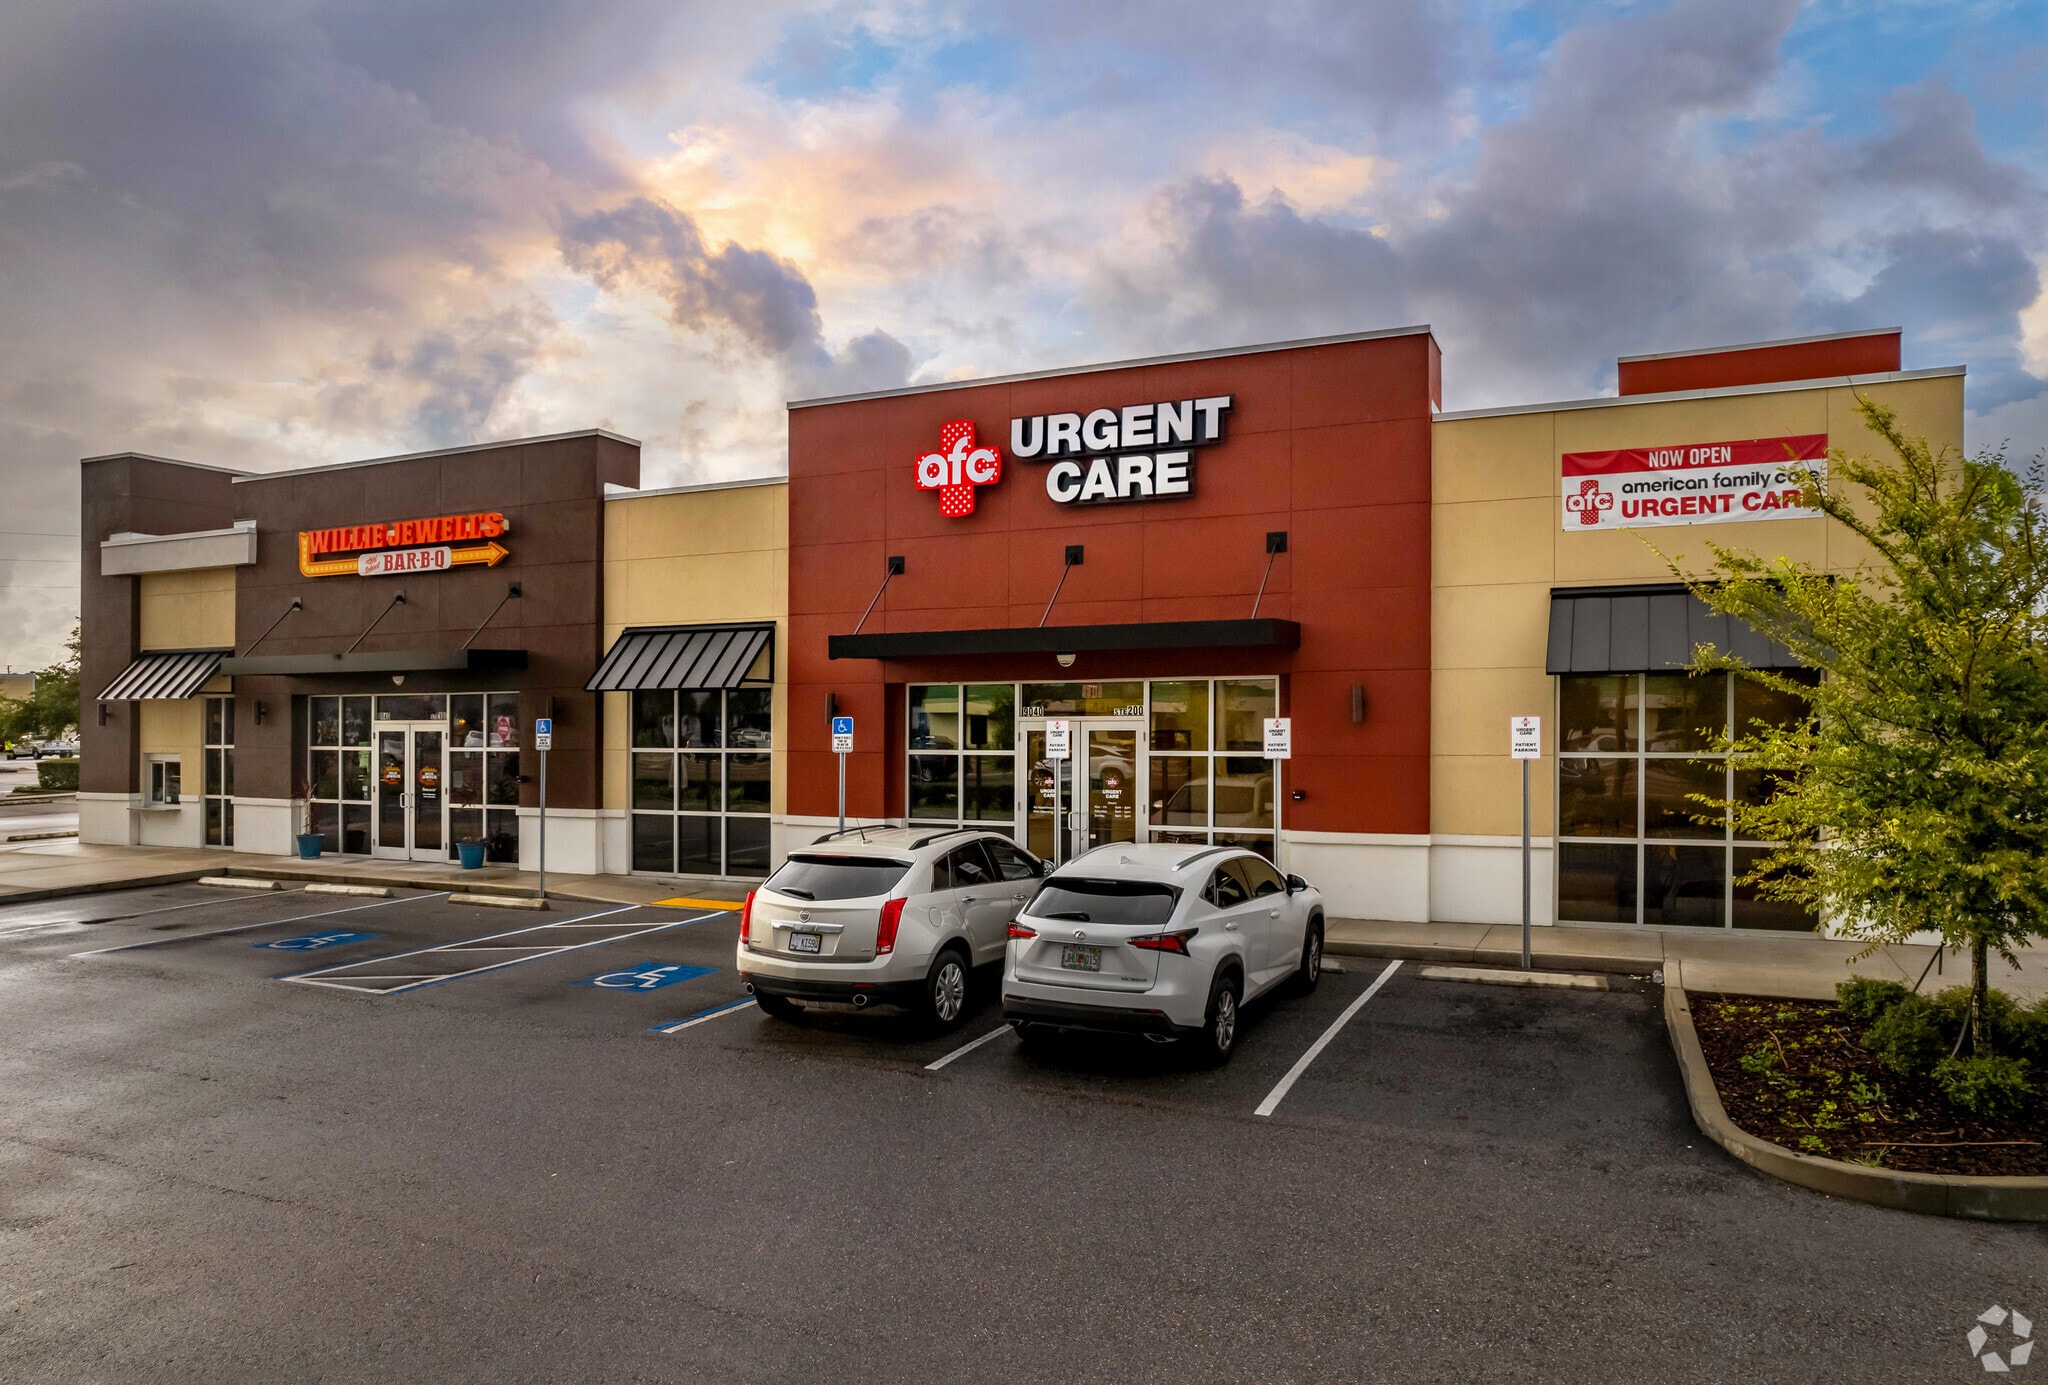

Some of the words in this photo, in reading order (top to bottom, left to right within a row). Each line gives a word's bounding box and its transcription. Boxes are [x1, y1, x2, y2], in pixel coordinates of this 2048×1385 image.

[1010, 395, 1231, 458] URGENT
[918, 436, 997, 488] afc
[1648, 449, 1684, 468] NOW
[1689, 446, 1732, 466] OPEN
[1046, 451, 1190, 503] CARE
[1621, 477, 1709, 494] american
[1712, 472, 1771, 489] family
[1567, 487, 1612, 511] afc
[1621, 494, 1736, 519] URGENT
[1741, 488, 1818, 512] CAR
[308, 523, 388, 554] WILLIE
[387, 511, 504, 547] JEWELL'S
[383, 549, 445, 572] BAR-B-Q
[1023, 706, 1044, 717] 9040
[1114, 707, 1128, 716] STE
[1127, 705, 1144, 716] 200
